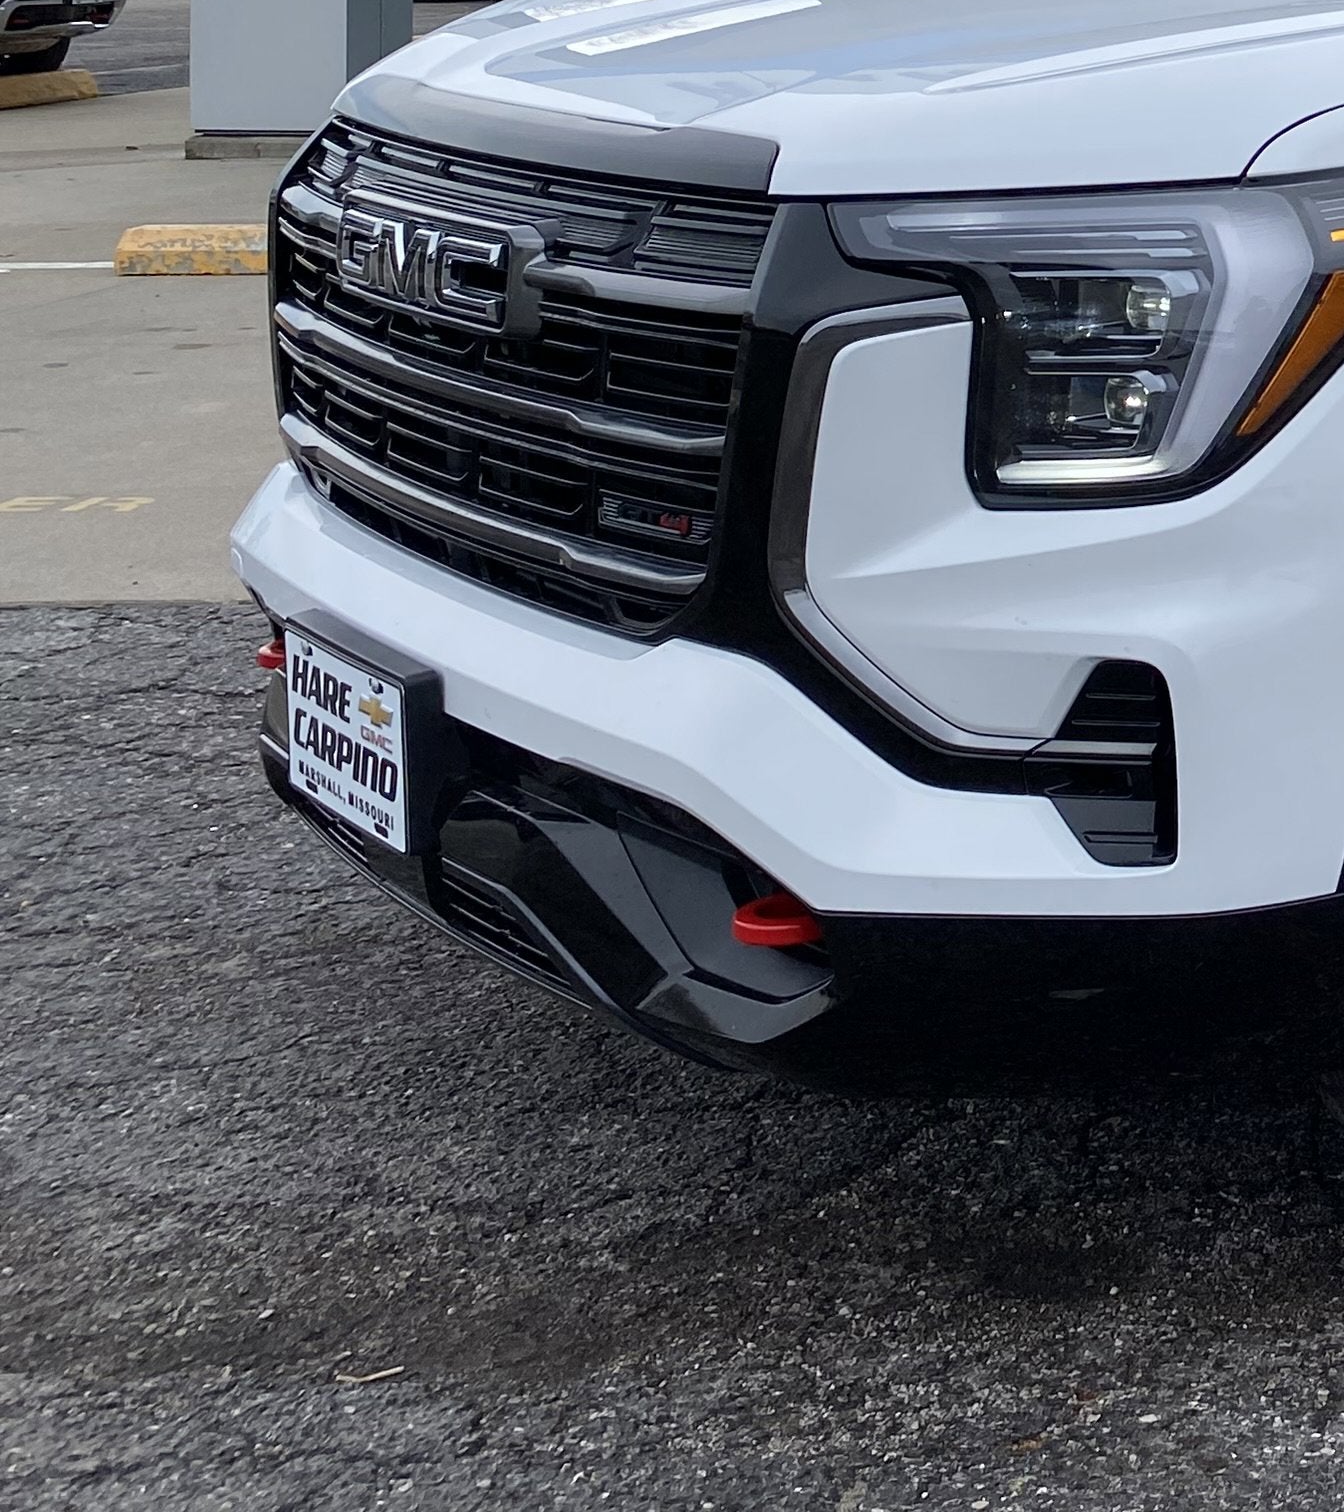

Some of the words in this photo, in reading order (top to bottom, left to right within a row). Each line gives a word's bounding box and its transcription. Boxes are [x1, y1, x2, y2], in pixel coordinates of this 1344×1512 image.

[337, 208, 506, 323] GMC
[292, 653, 352, 724] HARE
[294, 707, 398, 803] CARPINO
[360, 724, 393, 754] GMC
[348, 790, 394, 829] MISSOURI
